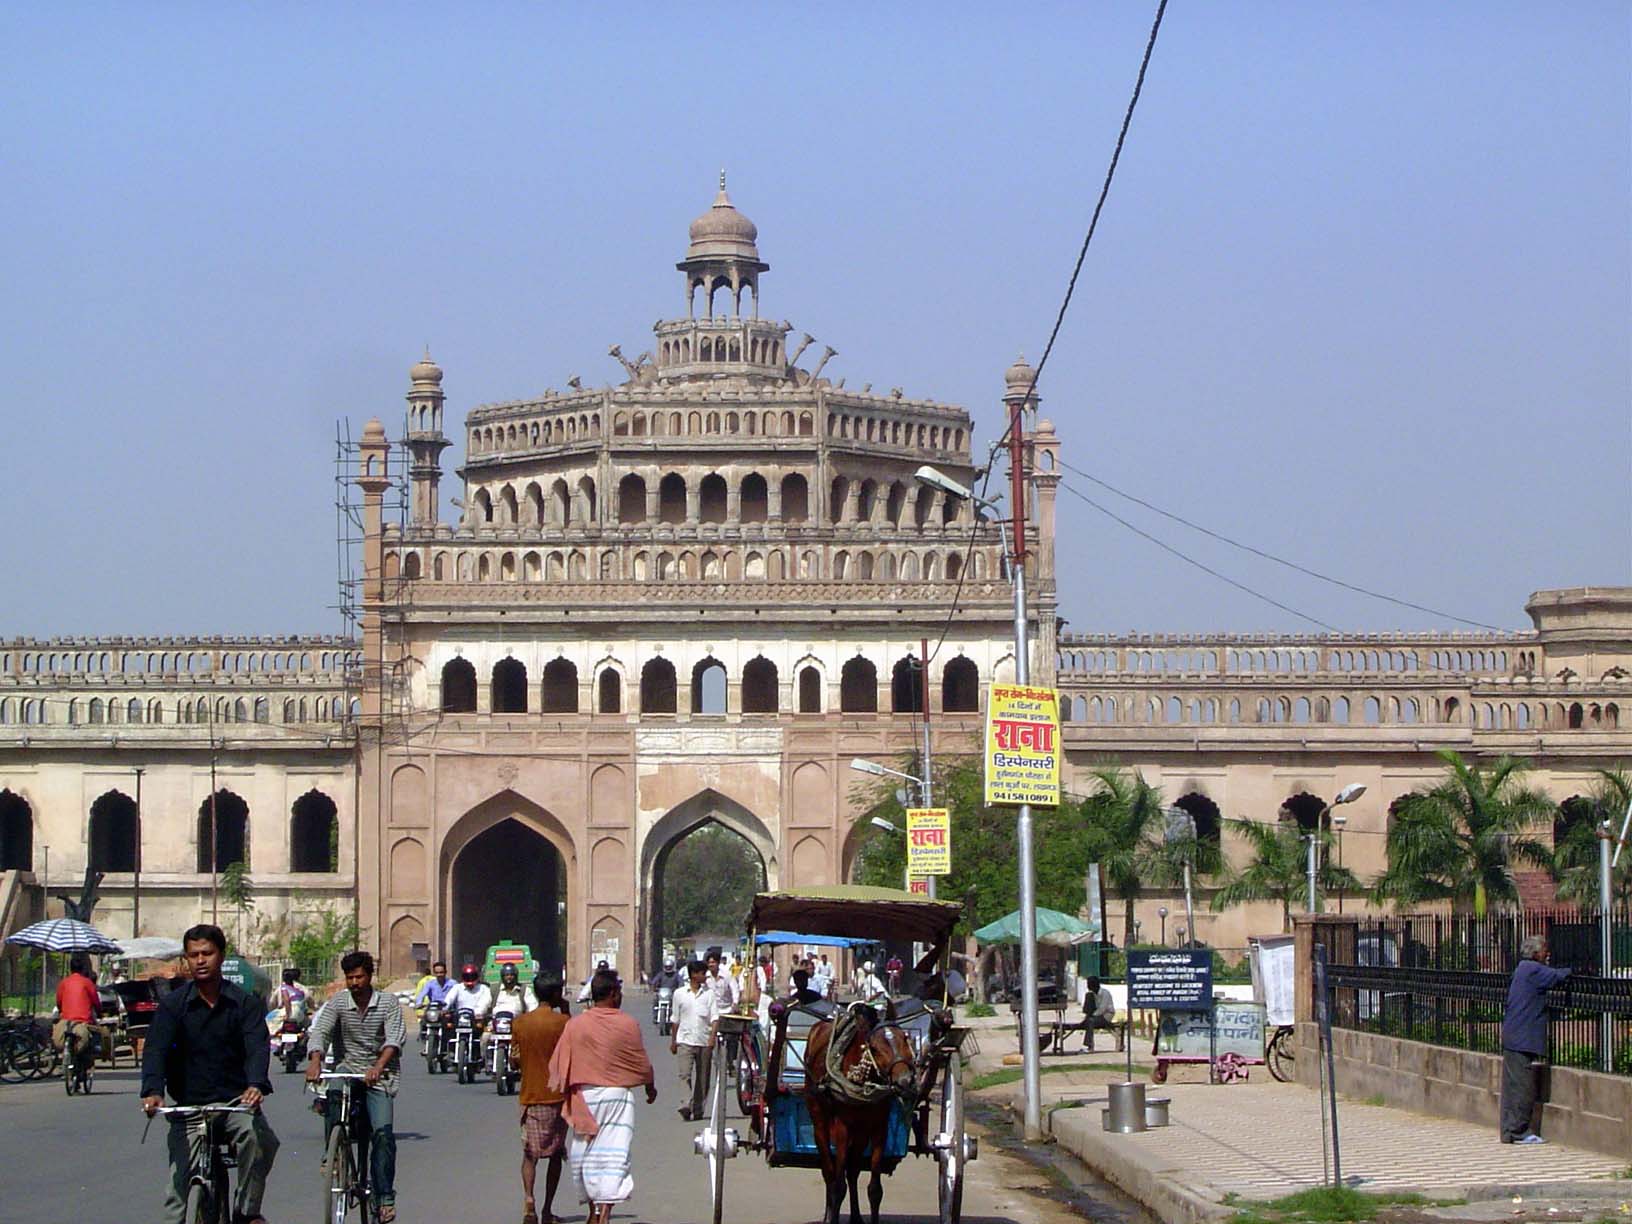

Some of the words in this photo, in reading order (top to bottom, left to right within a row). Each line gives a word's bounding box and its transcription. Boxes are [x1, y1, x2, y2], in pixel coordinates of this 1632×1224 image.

[992, 720, 1055, 752] राना
[994, 753, 1054, 769] डिस्पेनसरी
[993, 792, 1053, 802] 9415810891
[910, 829, 946, 846] राना
[911, 881, 928, 894] रान
